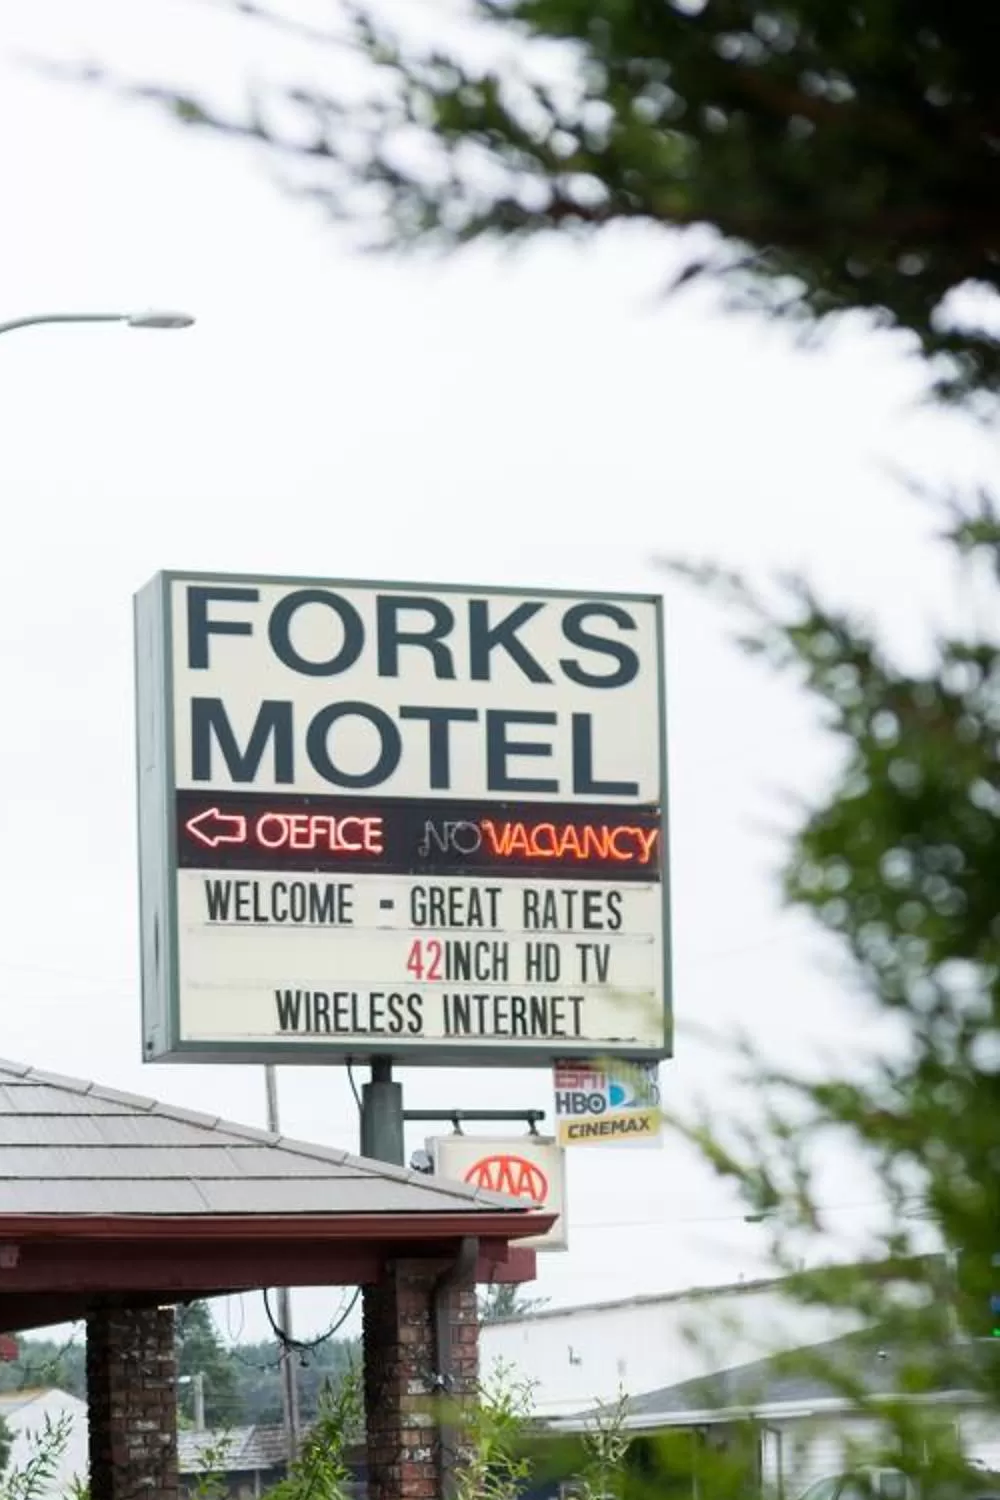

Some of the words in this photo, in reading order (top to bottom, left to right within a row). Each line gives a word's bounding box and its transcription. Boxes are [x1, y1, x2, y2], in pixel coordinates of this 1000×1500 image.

[186, 585, 640, 689] FORKS
[190, 696, 639, 797] MOTEL
[256, 813, 383, 853] OFFICE
[418, 819, 482, 856] NO
[480, 819, 660, 864] VACANCY
[204, 879, 354, 923] WELCOME
[410, 885, 502, 928] GREAT
[523, 888, 623, 931] RATES
[526, 942, 560, 982] HD
[576, 943, 610, 983] TV
[275, 989, 423, 1034] WIRELESS
[442, 993, 585, 1037] INTERNET
[555, 1092, 607, 1115] HBO
[567, 1116, 651, 1139] CINEMAX
[477, 1156, 538, 1201] AAA
